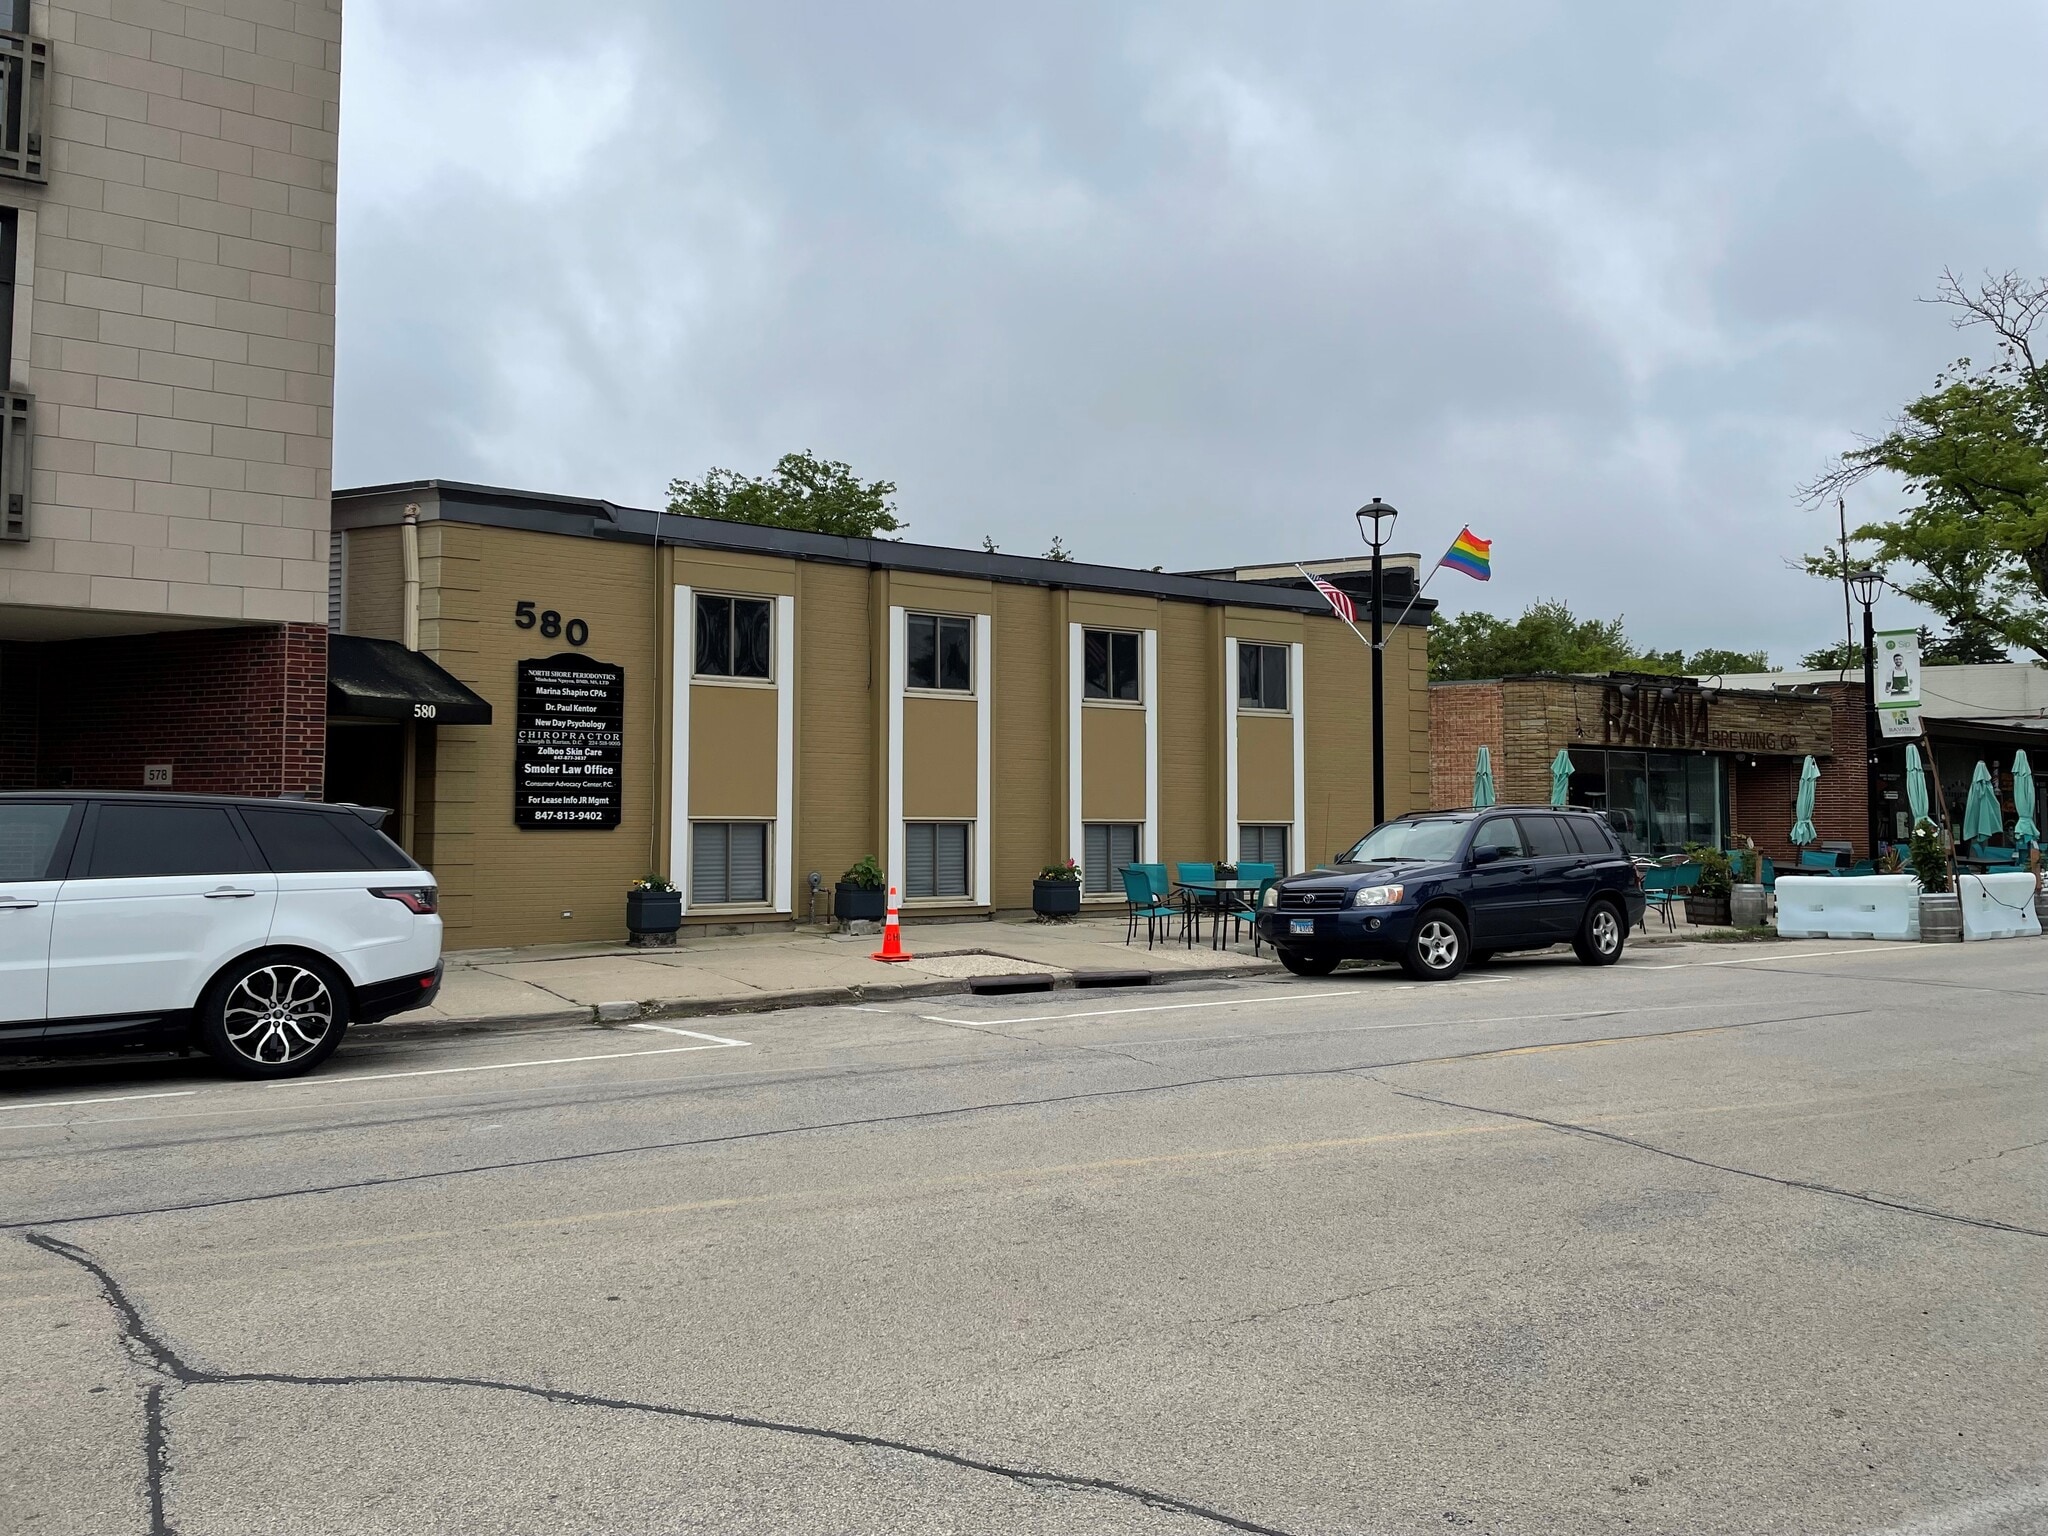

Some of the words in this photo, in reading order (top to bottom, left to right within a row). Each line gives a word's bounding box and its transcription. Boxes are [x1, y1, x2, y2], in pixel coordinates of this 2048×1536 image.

[515, 601, 588, 646] 580
[572, 672, 616, 680] PERIODONTICS
[536, 687, 561, 695] Marina
[562, 688, 589, 698] Shapiro
[589, 689, 607, 697] CPAs
[413, 704, 436, 718] 580
[545, 703, 556, 711] Dr.
[557, 704, 573, 712] Paul
[1603, 687, 1709, 747] RAVINIA
[1712, 730, 1776, 749] BREWING
[535, 718, 551, 726] New
[552, 719, 566, 728] Day
[567, 720, 606, 730] Psychology
[519, 730, 620, 741] CHIROPRACTOR
[537, 747, 564, 755] Zolboo
[566, 747, 583, 755] Skin
[584, 748, 602, 756] Care
[524, 763, 560, 774] Smoler
[562, 764, 582, 774] Law
[584, 764, 614, 775] Office
[149, 769, 168, 781] 578
[555, 781, 581, 789] Advocacy
[528, 796, 541, 804] For
[541, 796, 562, 804] Lease
[563, 796, 578, 804] Info
[578, 796, 587, 804] JR
[588, 796, 609, 806] Mgmt
[534, 811, 602, 820] 847-813-9402
